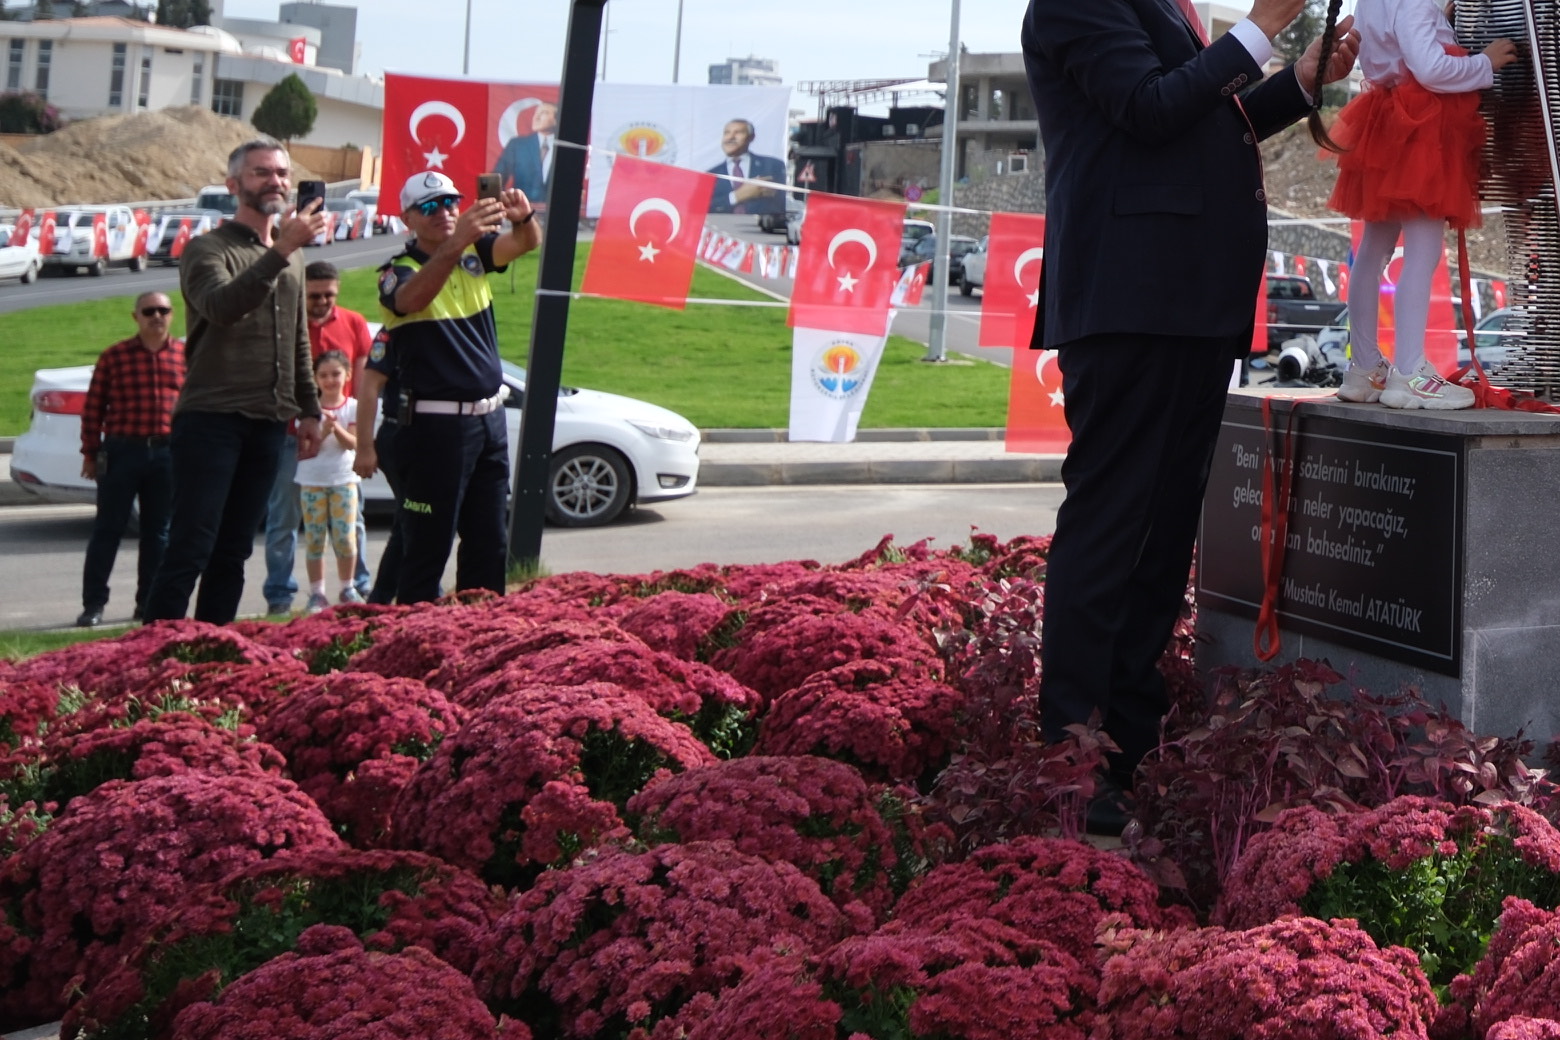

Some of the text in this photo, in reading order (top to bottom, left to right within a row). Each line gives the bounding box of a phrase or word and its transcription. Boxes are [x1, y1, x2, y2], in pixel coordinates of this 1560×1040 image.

[1299, 454, 1349, 485] sözlerini
[1354, 459, 1416, 500] bırakınız;
[1303, 491, 1333, 519] neler
[1338, 504, 1409, 539] yapacağız,
[1328, 588, 1364, 618] Kemal
[1365, 597, 1423, 633] ATATÜRK
